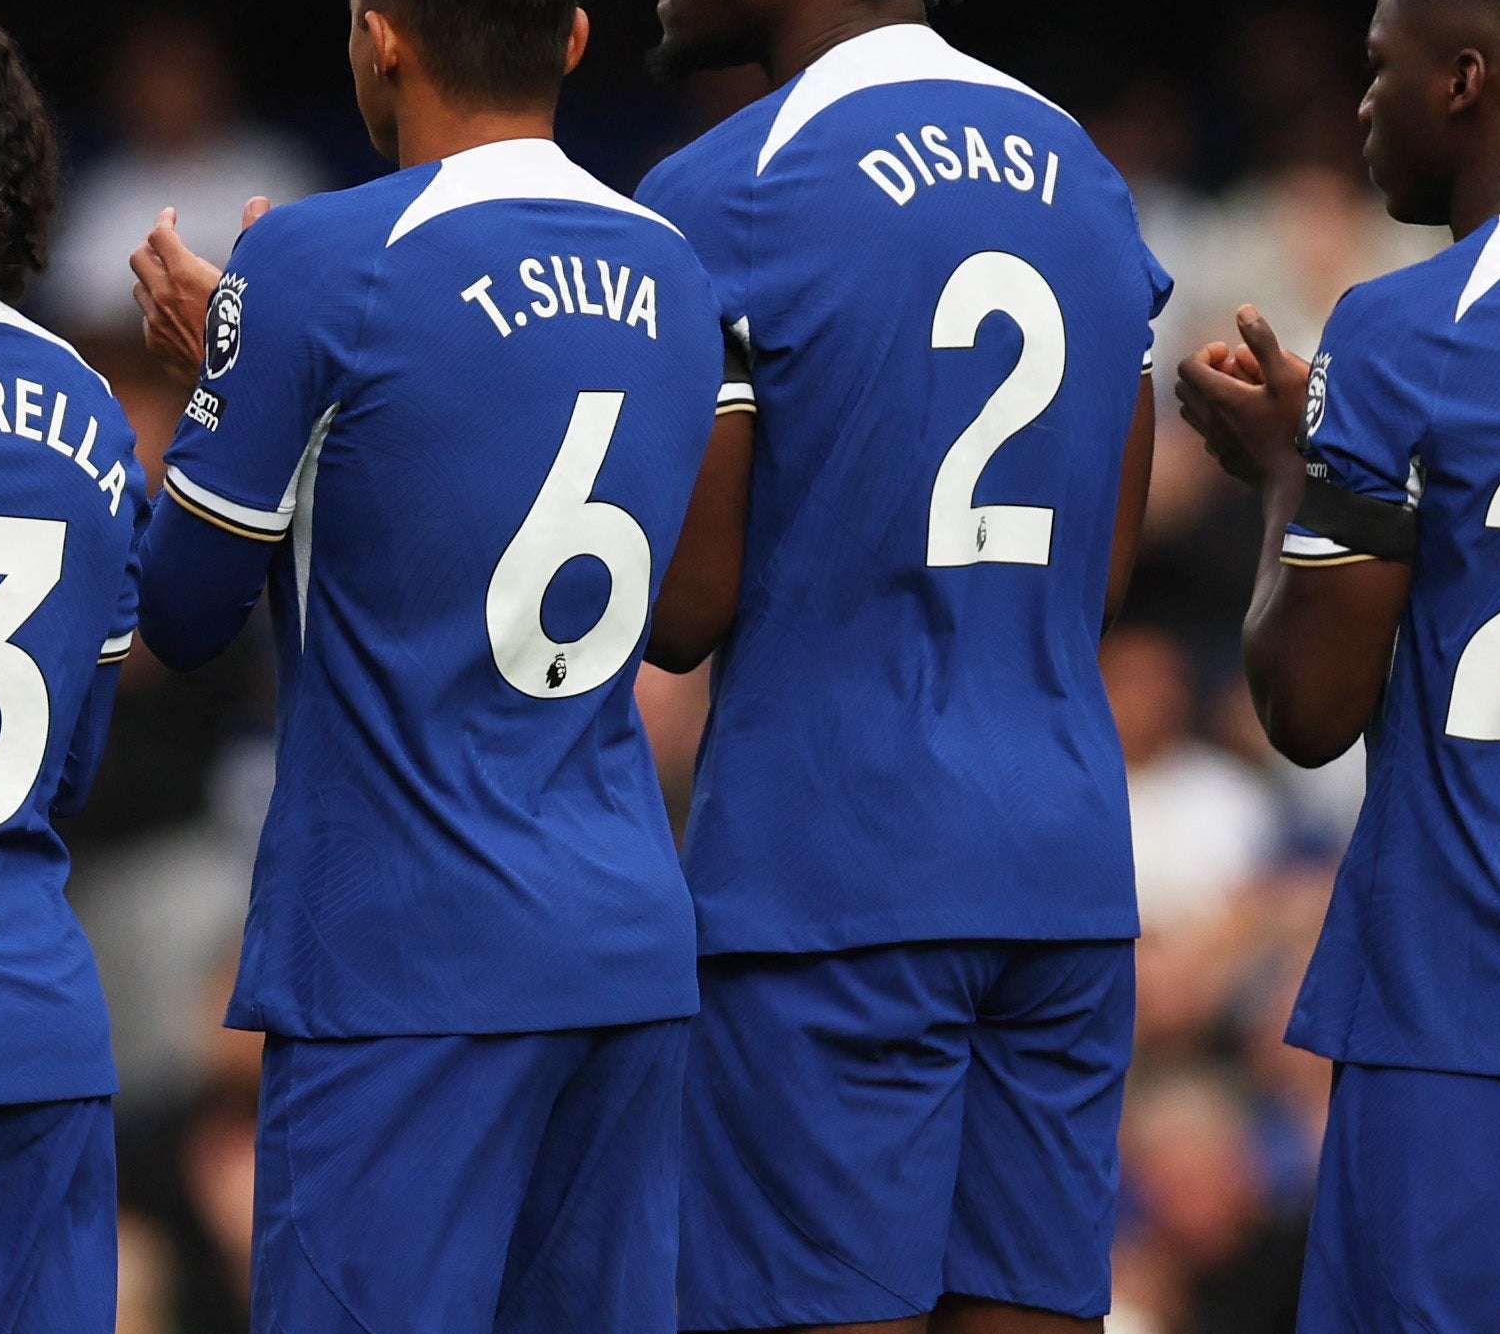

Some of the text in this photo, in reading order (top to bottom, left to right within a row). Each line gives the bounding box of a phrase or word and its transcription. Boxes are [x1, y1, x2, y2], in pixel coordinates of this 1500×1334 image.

[858, 124, 1058, 206] DISASI
[461, 255, 657, 340] T.SILVA
[926, 250, 1066, 568] 2
[485, 390, 652, 699] 6
